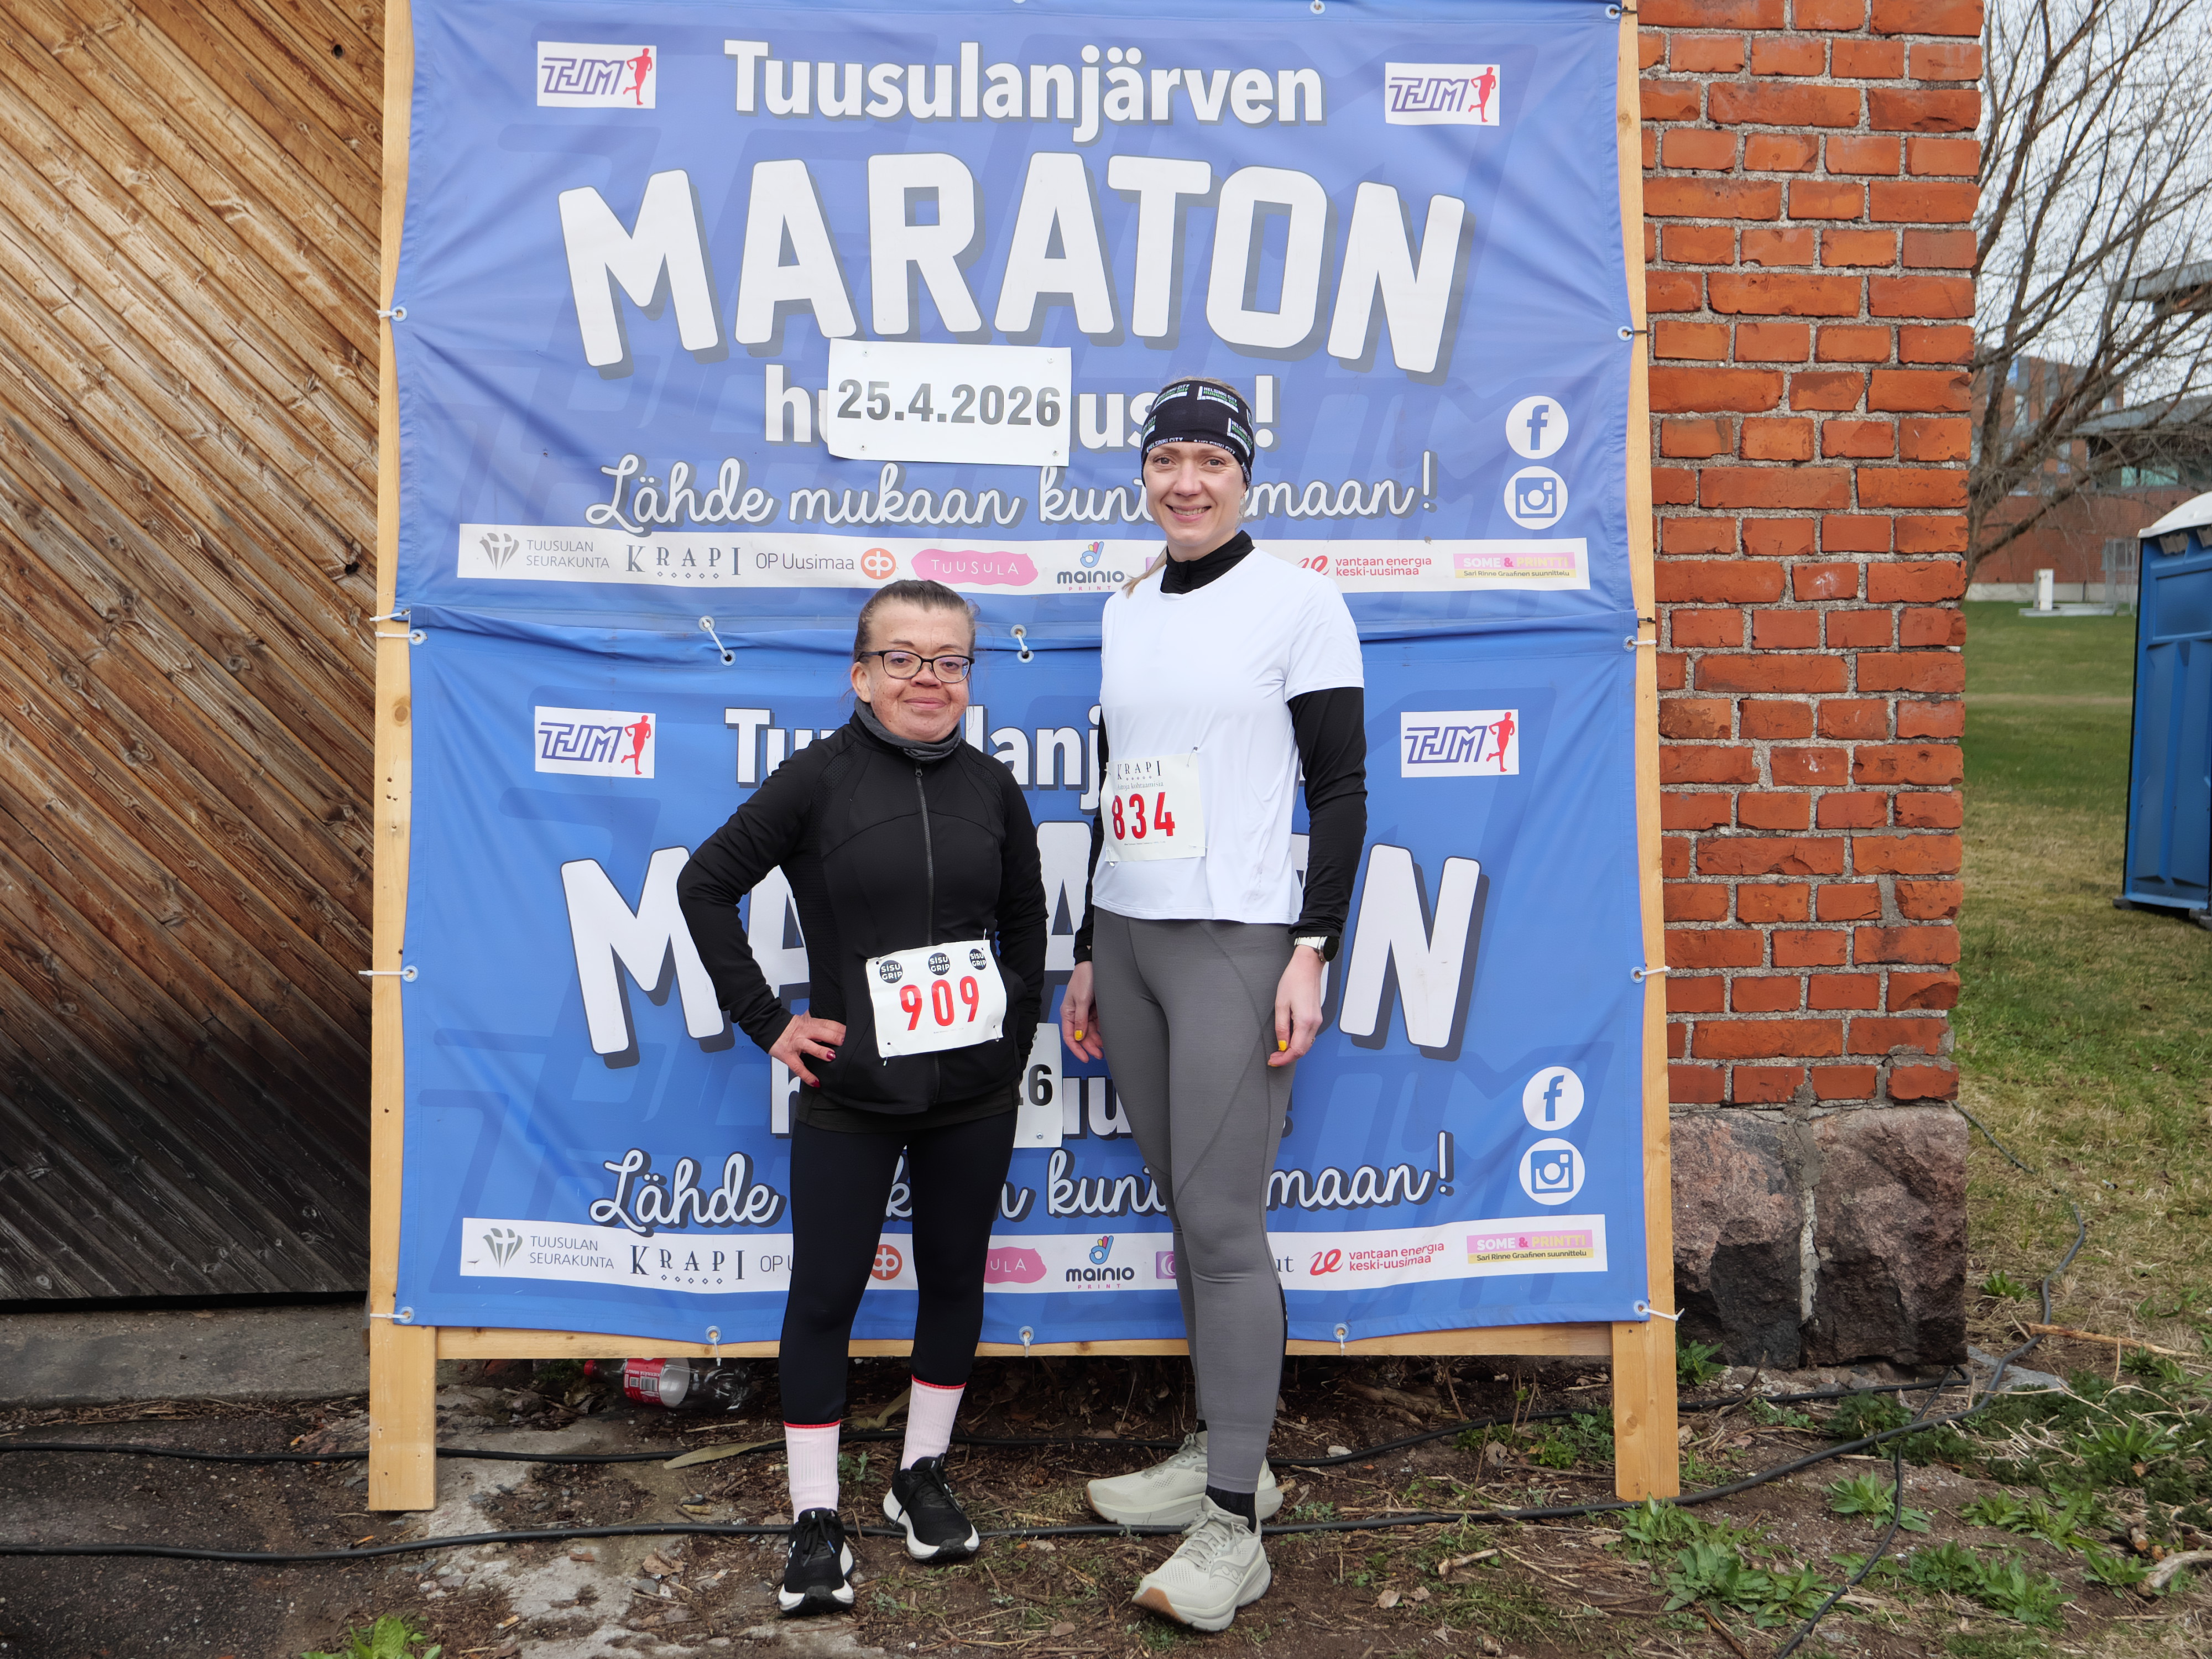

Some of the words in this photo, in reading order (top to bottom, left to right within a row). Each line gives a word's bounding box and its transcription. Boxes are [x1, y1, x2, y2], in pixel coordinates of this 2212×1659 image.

[724, 40, 1323, 142] Tuusulanjärven
[559, 152, 1465, 373] MARATON
[1203, 387, 1227, 398] HELSINKI
[1203, 390, 1228, 401] RUNNING
[837, 378, 1061, 427] 25.4.2026
[586, 454, 774, 533] Lähde
[790, 463, 1019, 524] mukaan
[527, 540, 593, 552] TUUSULAN
[526, 556, 609, 569] SEURAKUNTA
[625, 545, 741, 576] KRAPI
[756, 552, 778, 570] OP
[782, 552, 854, 571] Uusimaa
[931, 559, 1019, 575] TUUSULA
[1335, 557, 1384, 566] vantaan
[1386, 556, 1432, 567] energia
[1463, 557, 1501, 568] SOME
[1517, 557, 1568, 567] PRINTTI
[1057, 571, 1124, 585] mainio
[1335, 566, 1420, 576] keski-uusimaa
[1117, 760, 1162, 780] KRAPI
[1131, 780, 1164, 789] kohtaamisia
[1112, 792, 1176, 840] 834
[930, 956, 949, 964] SISU
[970, 952, 984, 960] SISU
[972, 959, 987, 967] GRIP
[881, 963, 901, 973] SISU
[930, 964, 951, 972] GRIP
[881, 972, 902, 980] GRIP
[899, 975, 979, 1031] 909
[589, 1150, 779, 1232] Lähde
[530, 1236, 598, 1251] TUUSULAN
[1477, 1237, 1516, 1251] SOME
[1532, 1234, 1585, 1248] PRINTTI
[1349, 1249, 1398, 1260] vantaan
[1401, 1242, 1444, 1258] energia
[1512, 1251, 1546, 1260] Graafinen
[1547, 1249, 1587, 1258] suunnittelu
[529, 1253, 614, 1269] SEURAKUNTA
[630, 1245, 745, 1280] KRAPI
[760, 1255, 782, 1272] OP
[1349, 1254, 1431, 1271] keski-uusimaa
[1066, 1267, 1135, 1282] mainio
